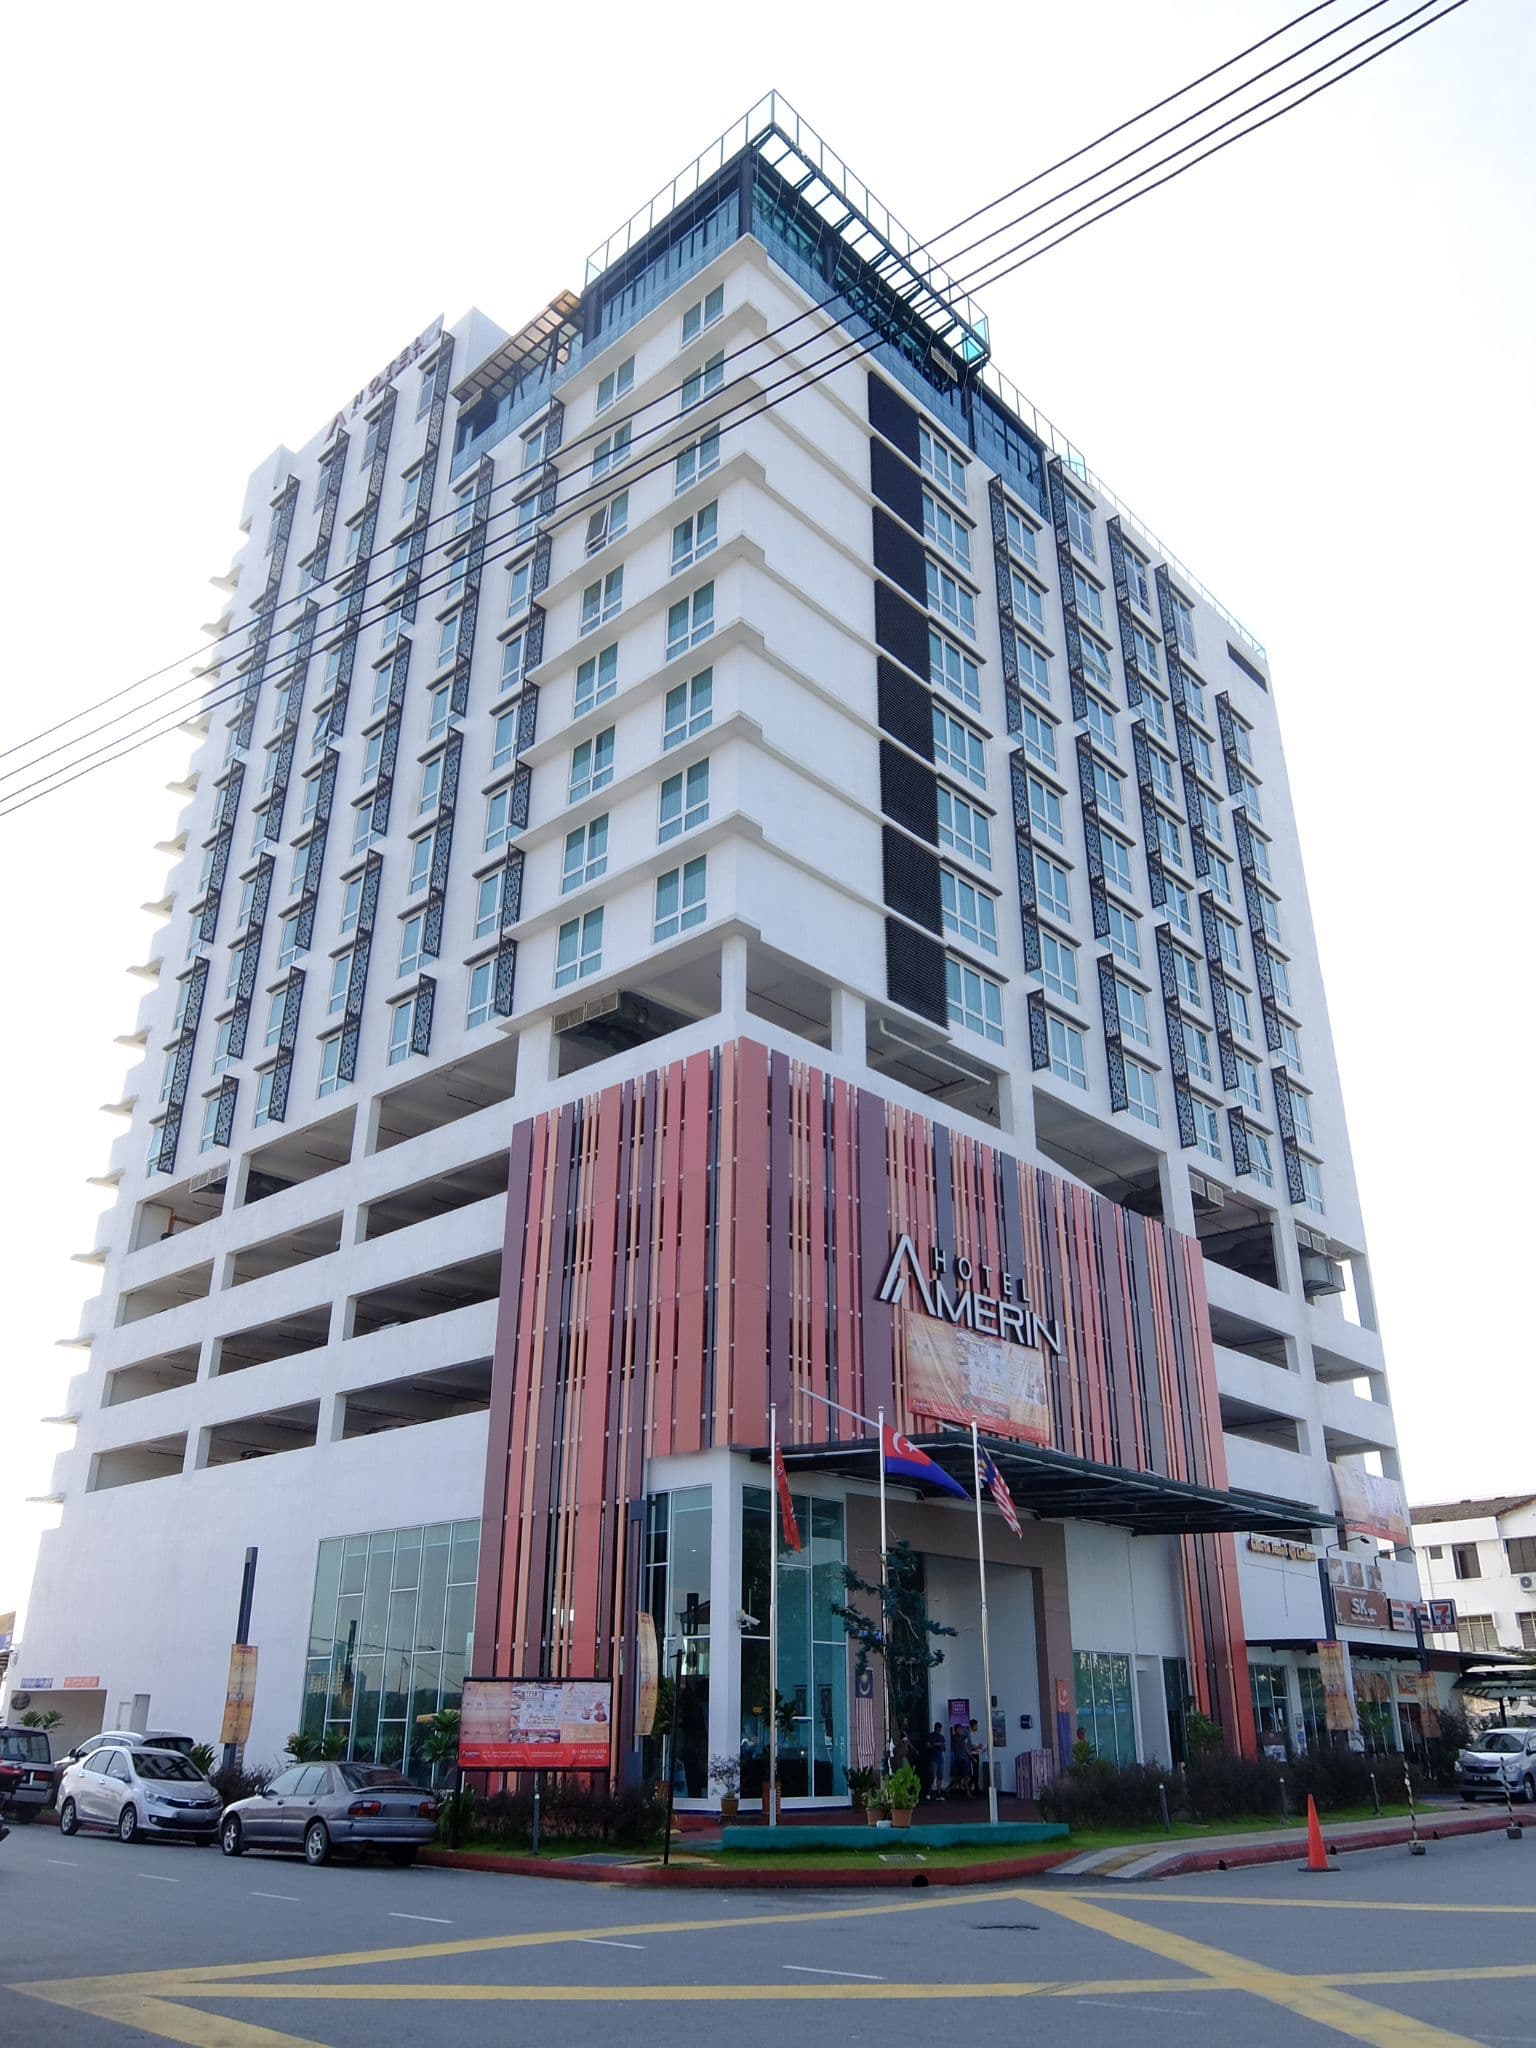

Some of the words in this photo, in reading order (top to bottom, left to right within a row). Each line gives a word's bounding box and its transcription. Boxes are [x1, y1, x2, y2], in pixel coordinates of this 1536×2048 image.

[879, 1233, 1062, 1355] AMERIN
[934, 1247, 1031, 1302] HOTEL
[1351, 1597, 1369, 1616] SK
